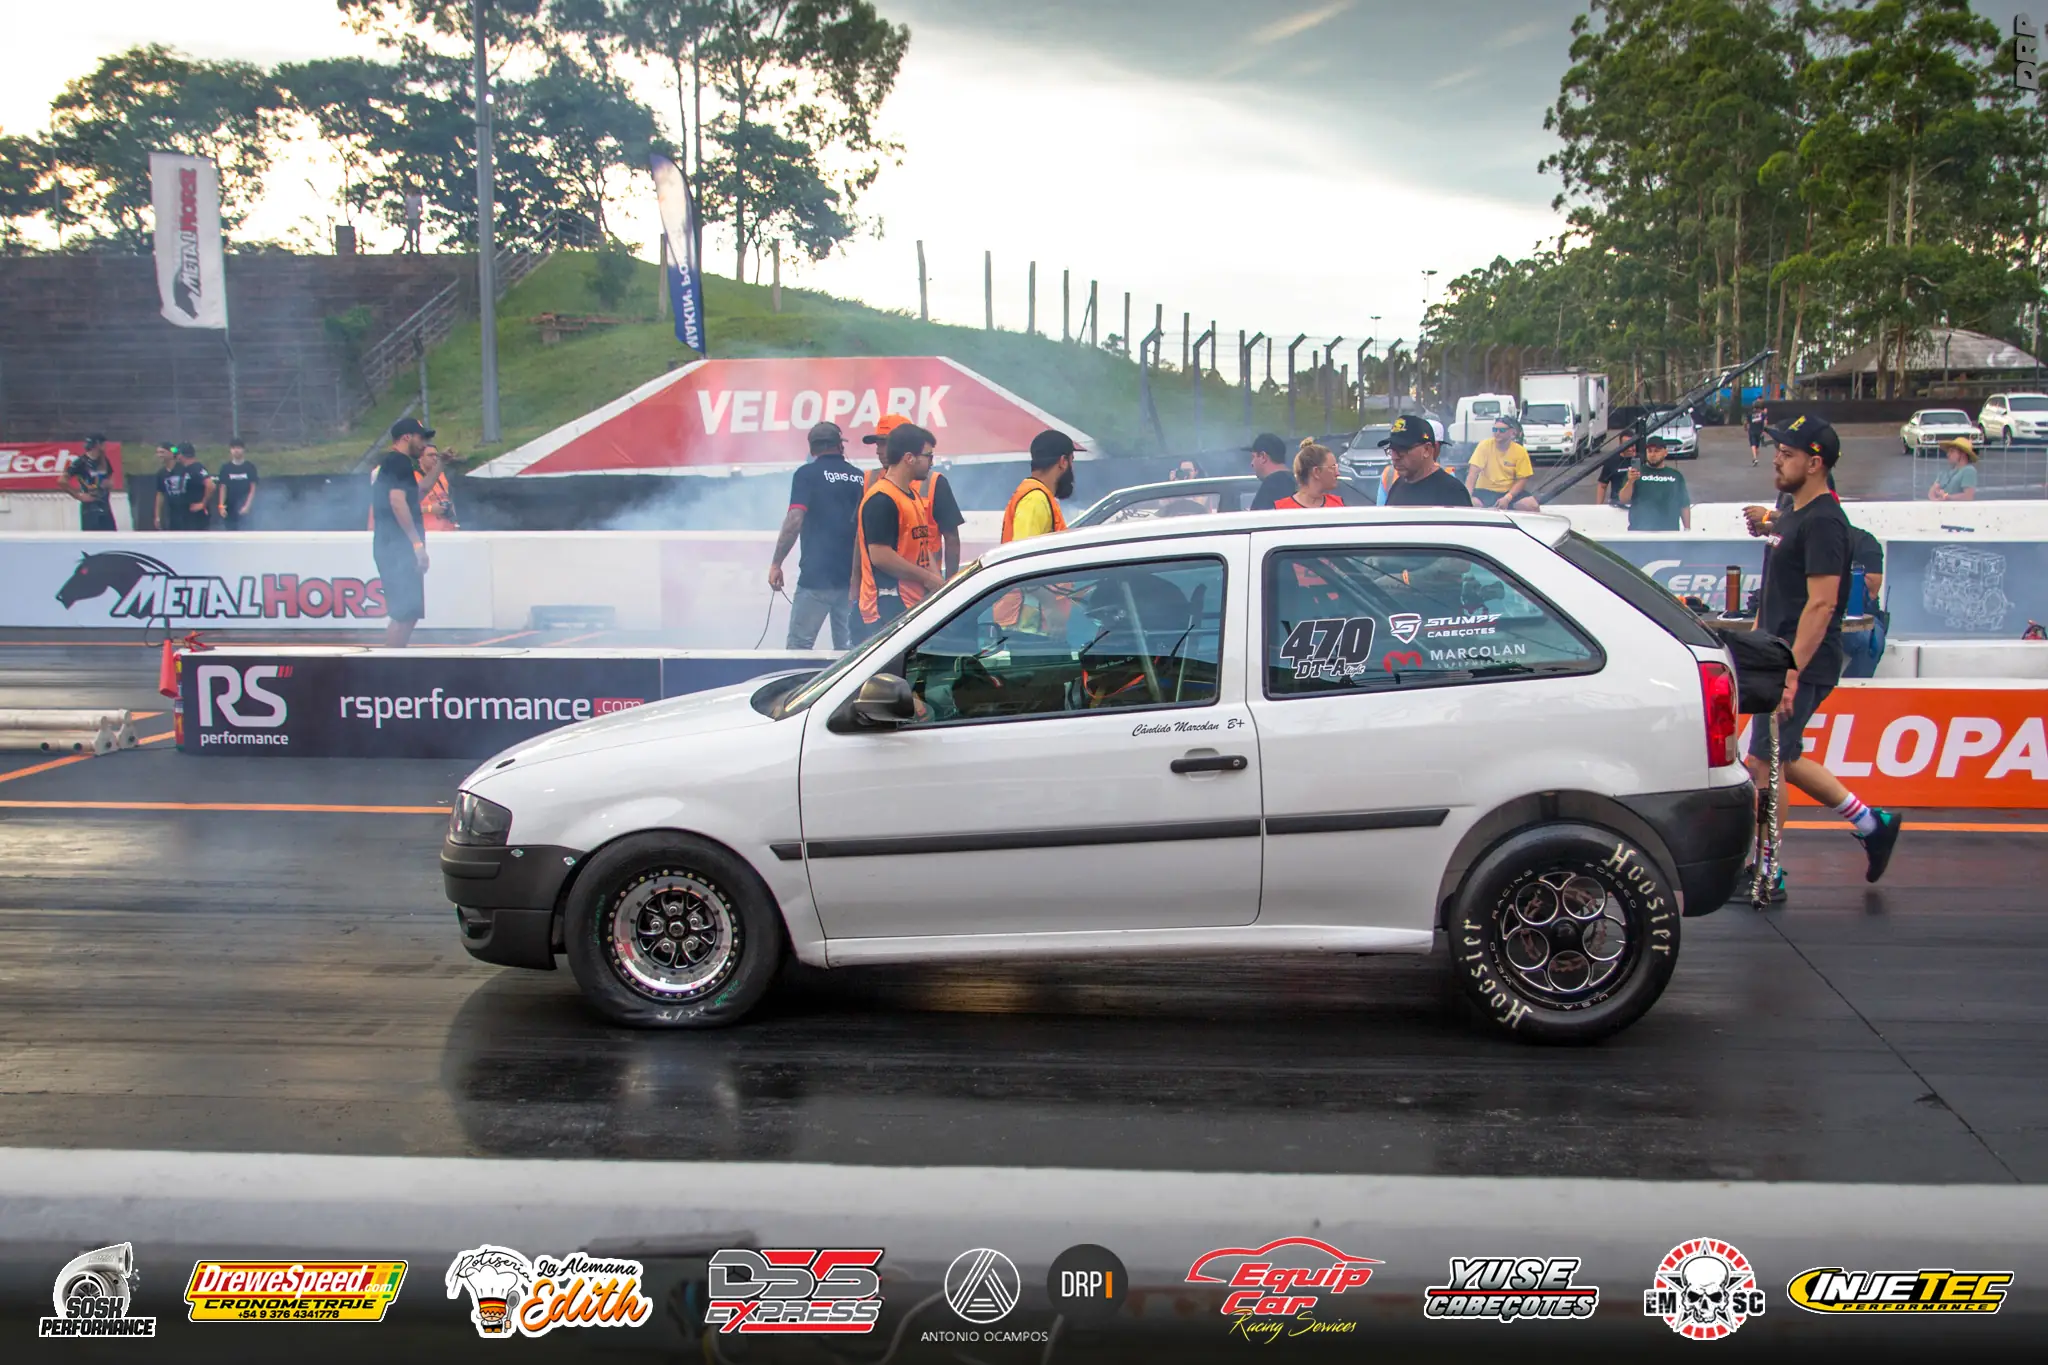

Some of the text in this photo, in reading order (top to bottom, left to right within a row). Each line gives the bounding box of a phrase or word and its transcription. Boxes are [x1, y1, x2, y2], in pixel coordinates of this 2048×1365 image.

[697, 384, 952, 435] VELOPARK
[1641, 474, 1668, 483] adidas
[1280, 617, 1375, 669] 470
[1424, 613, 1502, 627] STUMPF
[1427, 627, 1496, 638] CABEÇOTES
[1430, 644, 1526, 661] MARCOLAN
[196, 665, 288, 727] RS
[200, 730, 289, 746] performance
[1132, 718, 1245, 736] Cândido Marcolan B+
[1492, 870, 1533, 919] RACING
[1584, 862, 1636, 909] FORGED
[1602, 843, 1676, 956] Hoosier
[1459, 919, 1533, 1029] Hoosier
